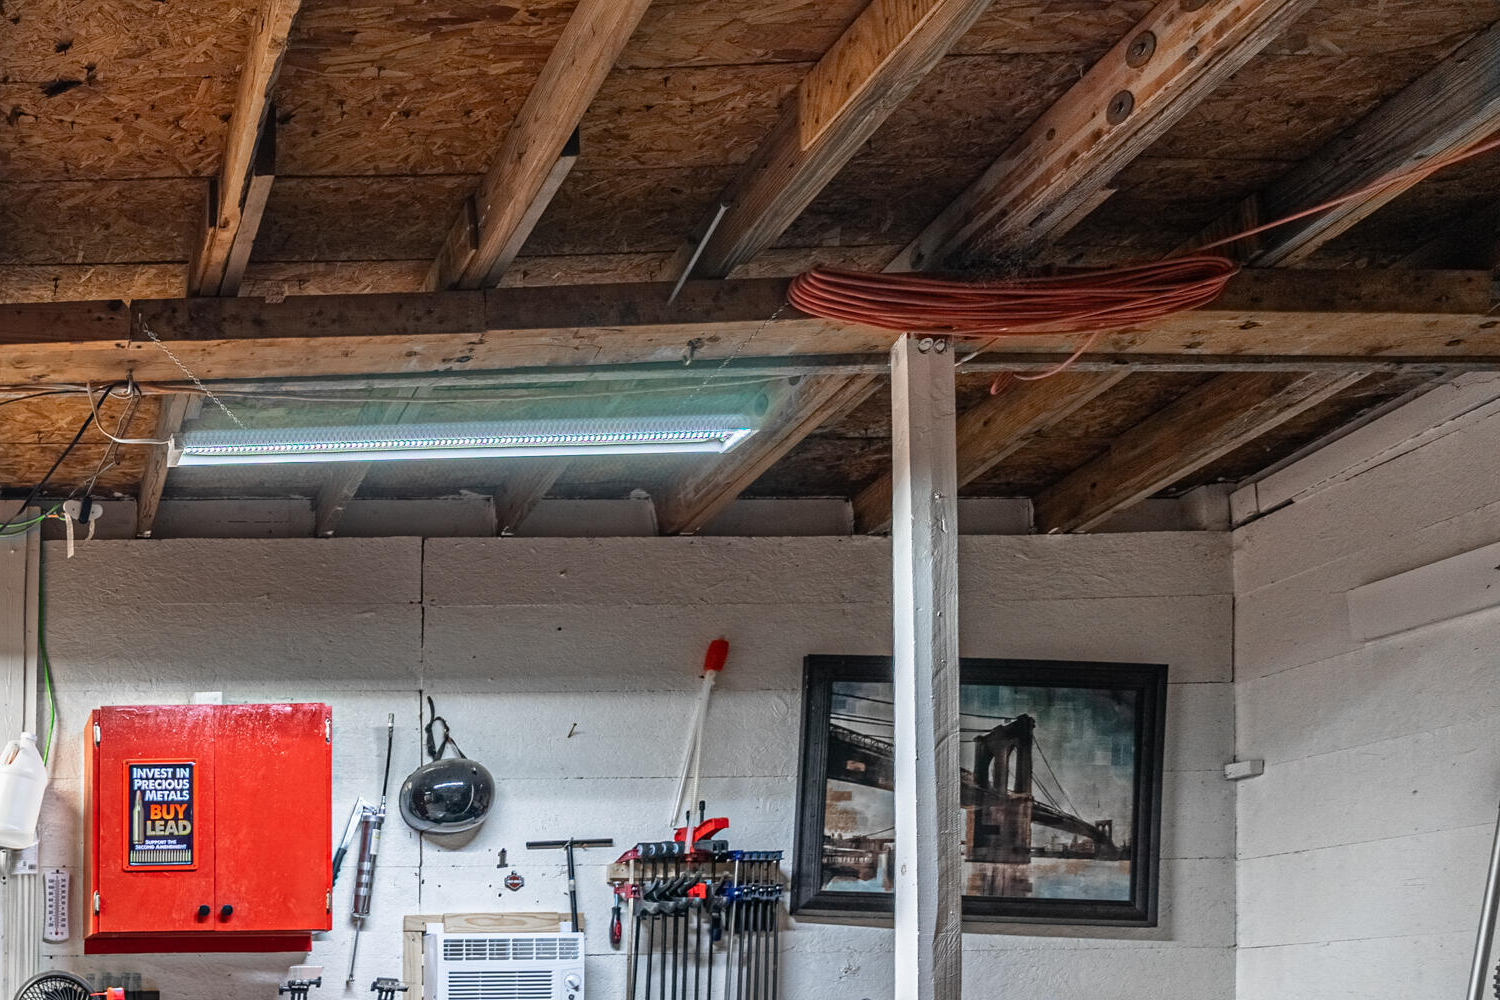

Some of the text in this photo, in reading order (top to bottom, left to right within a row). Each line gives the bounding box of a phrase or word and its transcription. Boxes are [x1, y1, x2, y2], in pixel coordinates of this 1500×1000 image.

[132, 767, 190, 779] INVEST IN
[133, 779, 190, 790] PRECIOUS
[144, 790, 190, 801] METALS
[150, 803, 188, 820] BUY
[146, 820, 192, 836] LEAD
